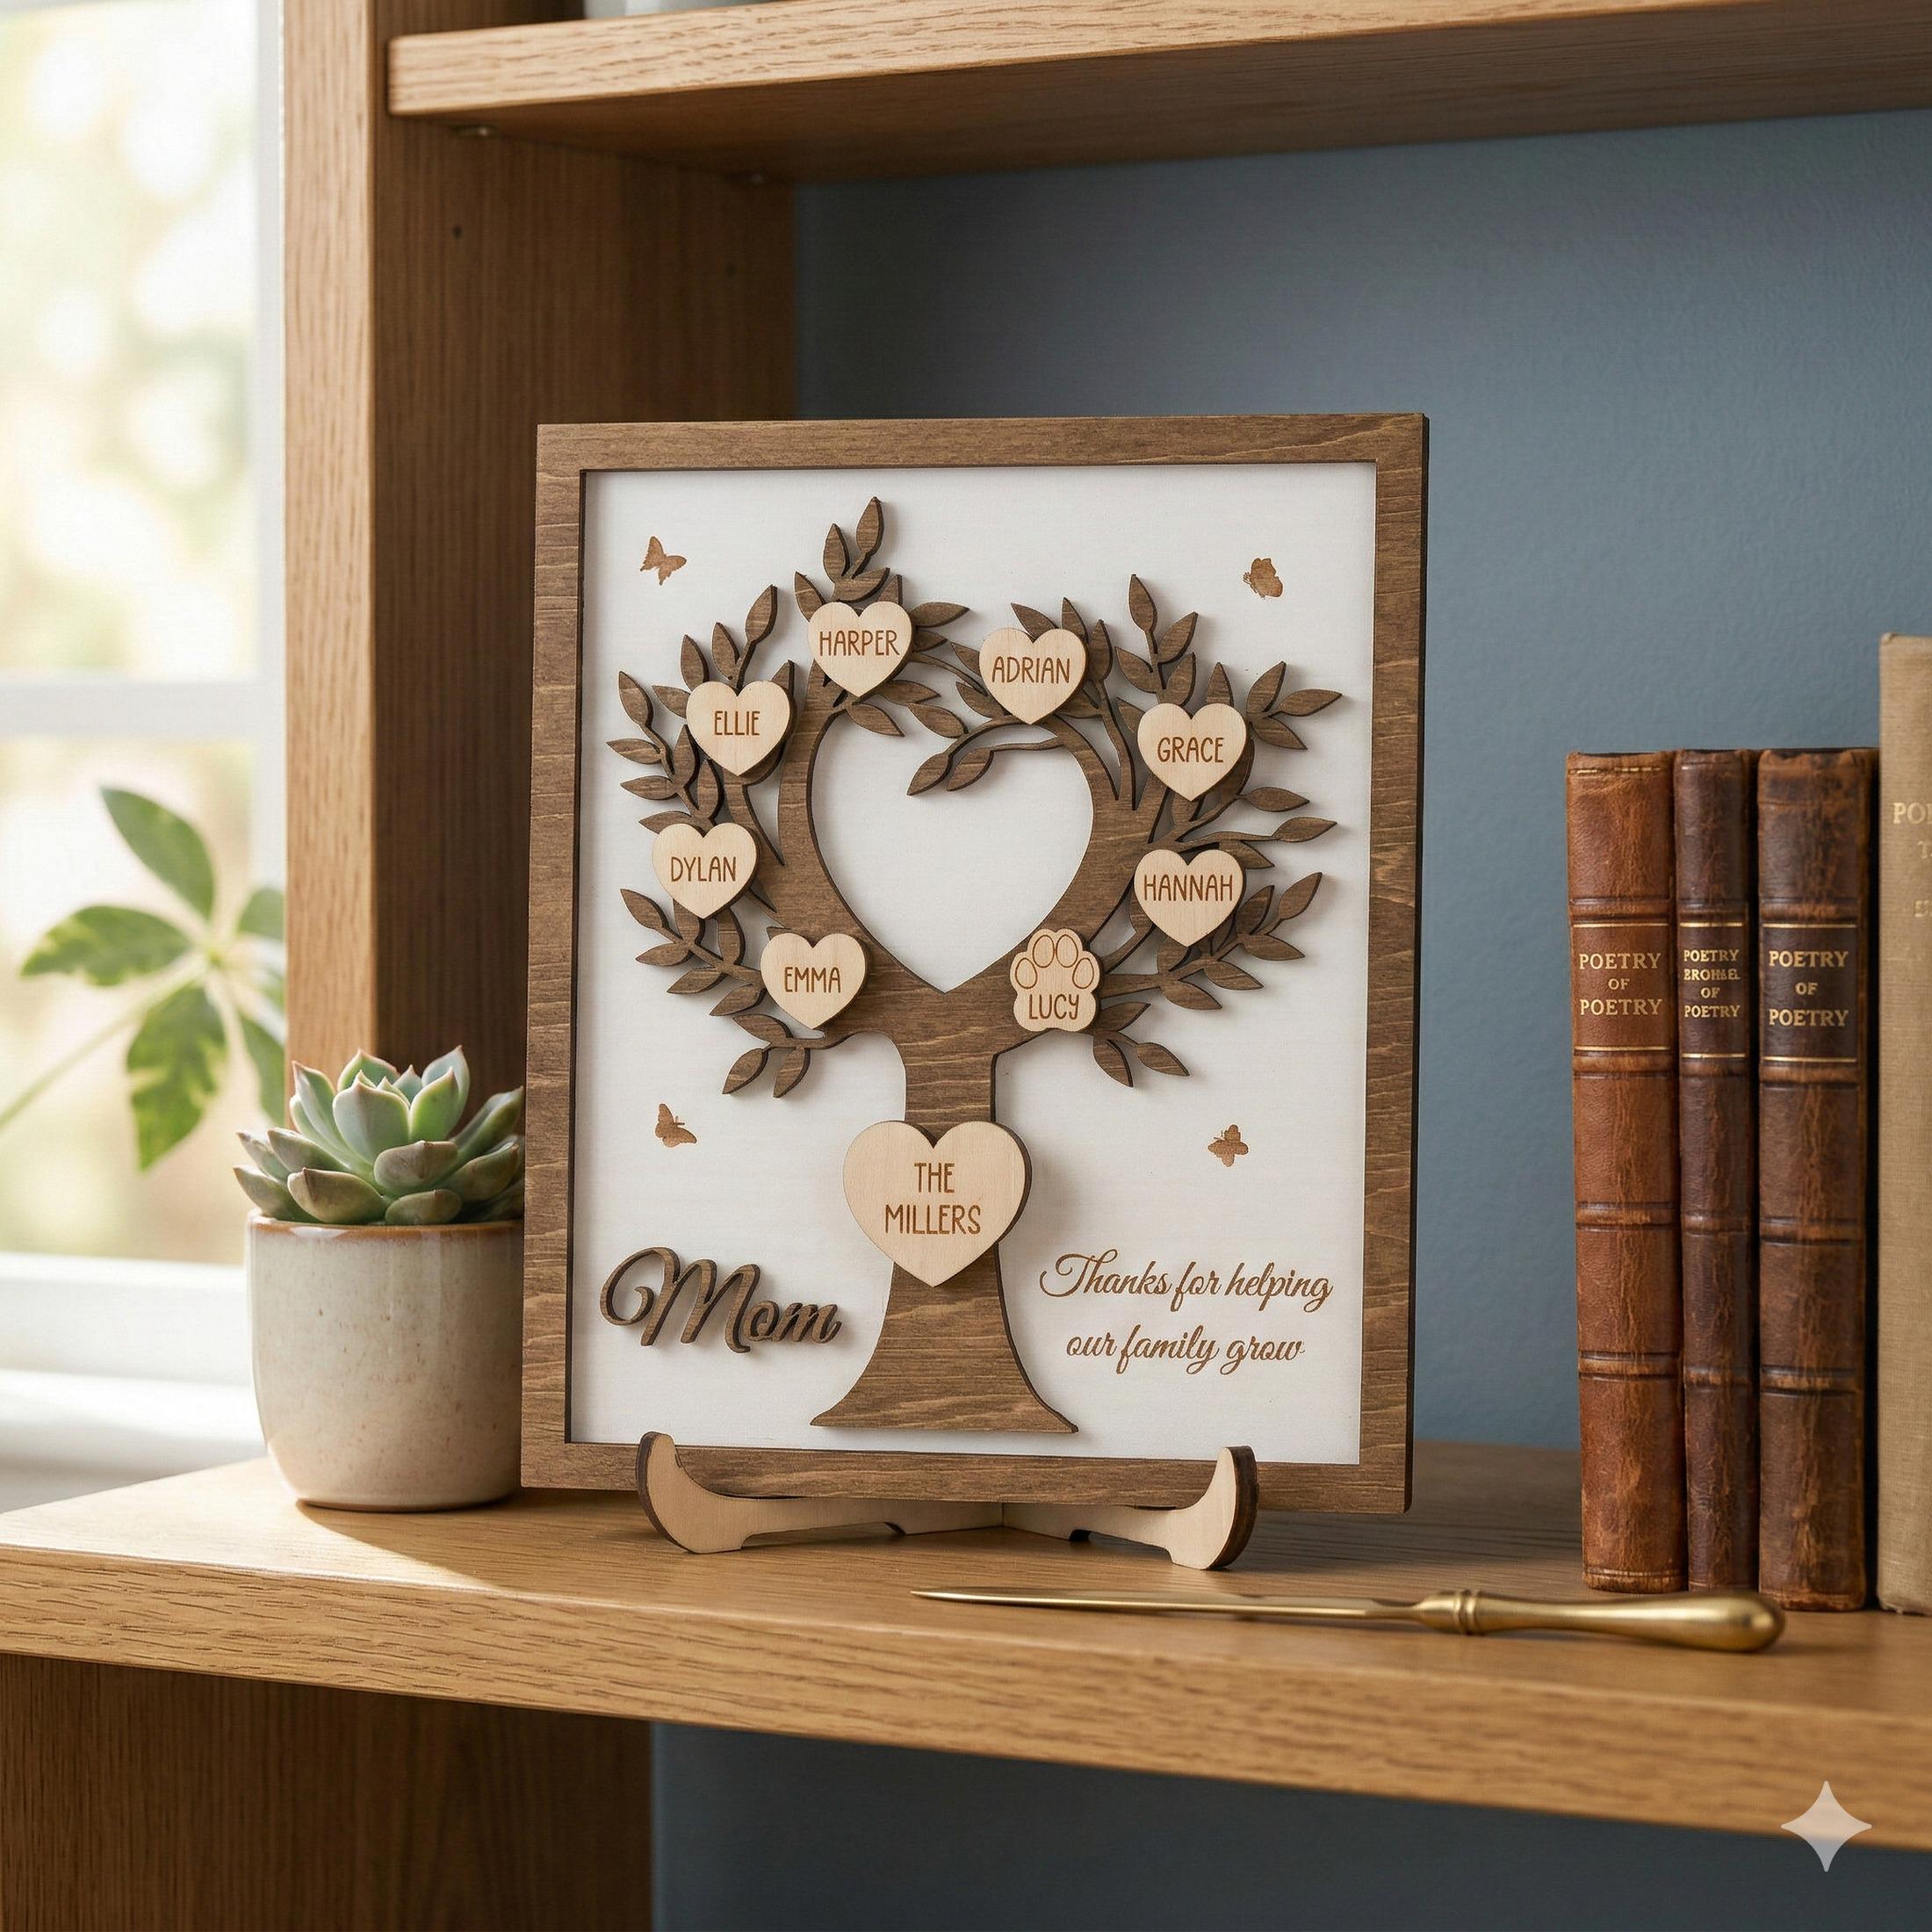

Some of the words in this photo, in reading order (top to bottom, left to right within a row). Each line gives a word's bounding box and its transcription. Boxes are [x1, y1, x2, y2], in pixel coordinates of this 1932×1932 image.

[818, 630, 900, 657] HARPER
[991, 656, 1070, 684] ADRIAN
[713, 710, 761, 736] ELLIE
[1157, 737, 1224, 763] GRACE
[670, 856, 736, 883] DYLAN
[1143, 874, 1233, 902] HANNAH
[1579, 953, 1662, 970] POETRY
[1683, 949, 1740, 962] POETRY
[1769, 951, 1849, 968] POETRY
[784, 967, 841, 993] EMMA
[1608, 978, 1630, 990] OF
[1700, 987, 1720, 998] OF
[1795, 982, 1818, 996] OF
[1028, 993, 1080, 1020] LUCY
[1579, 998, 1662, 1015] POETRY
[1684, 1005, 1741, 1018] POETRY
[1769, 1009, 1849, 1027] POETRY
[914, 1163, 955, 1193] THE
[885, 1204, 982, 1235] MILLERS
[1040, 1248, 1172, 1298] Thanks
[1170, 1261, 1222, 1312] for
[1223, 1262, 1334, 1313] helping
[600, 1247, 843, 1353] Mom
[1065, 1335, 1117, 1357] our
[1115, 1324, 1221, 1375] family
[1219, 1335, 1306, 1376] grow
